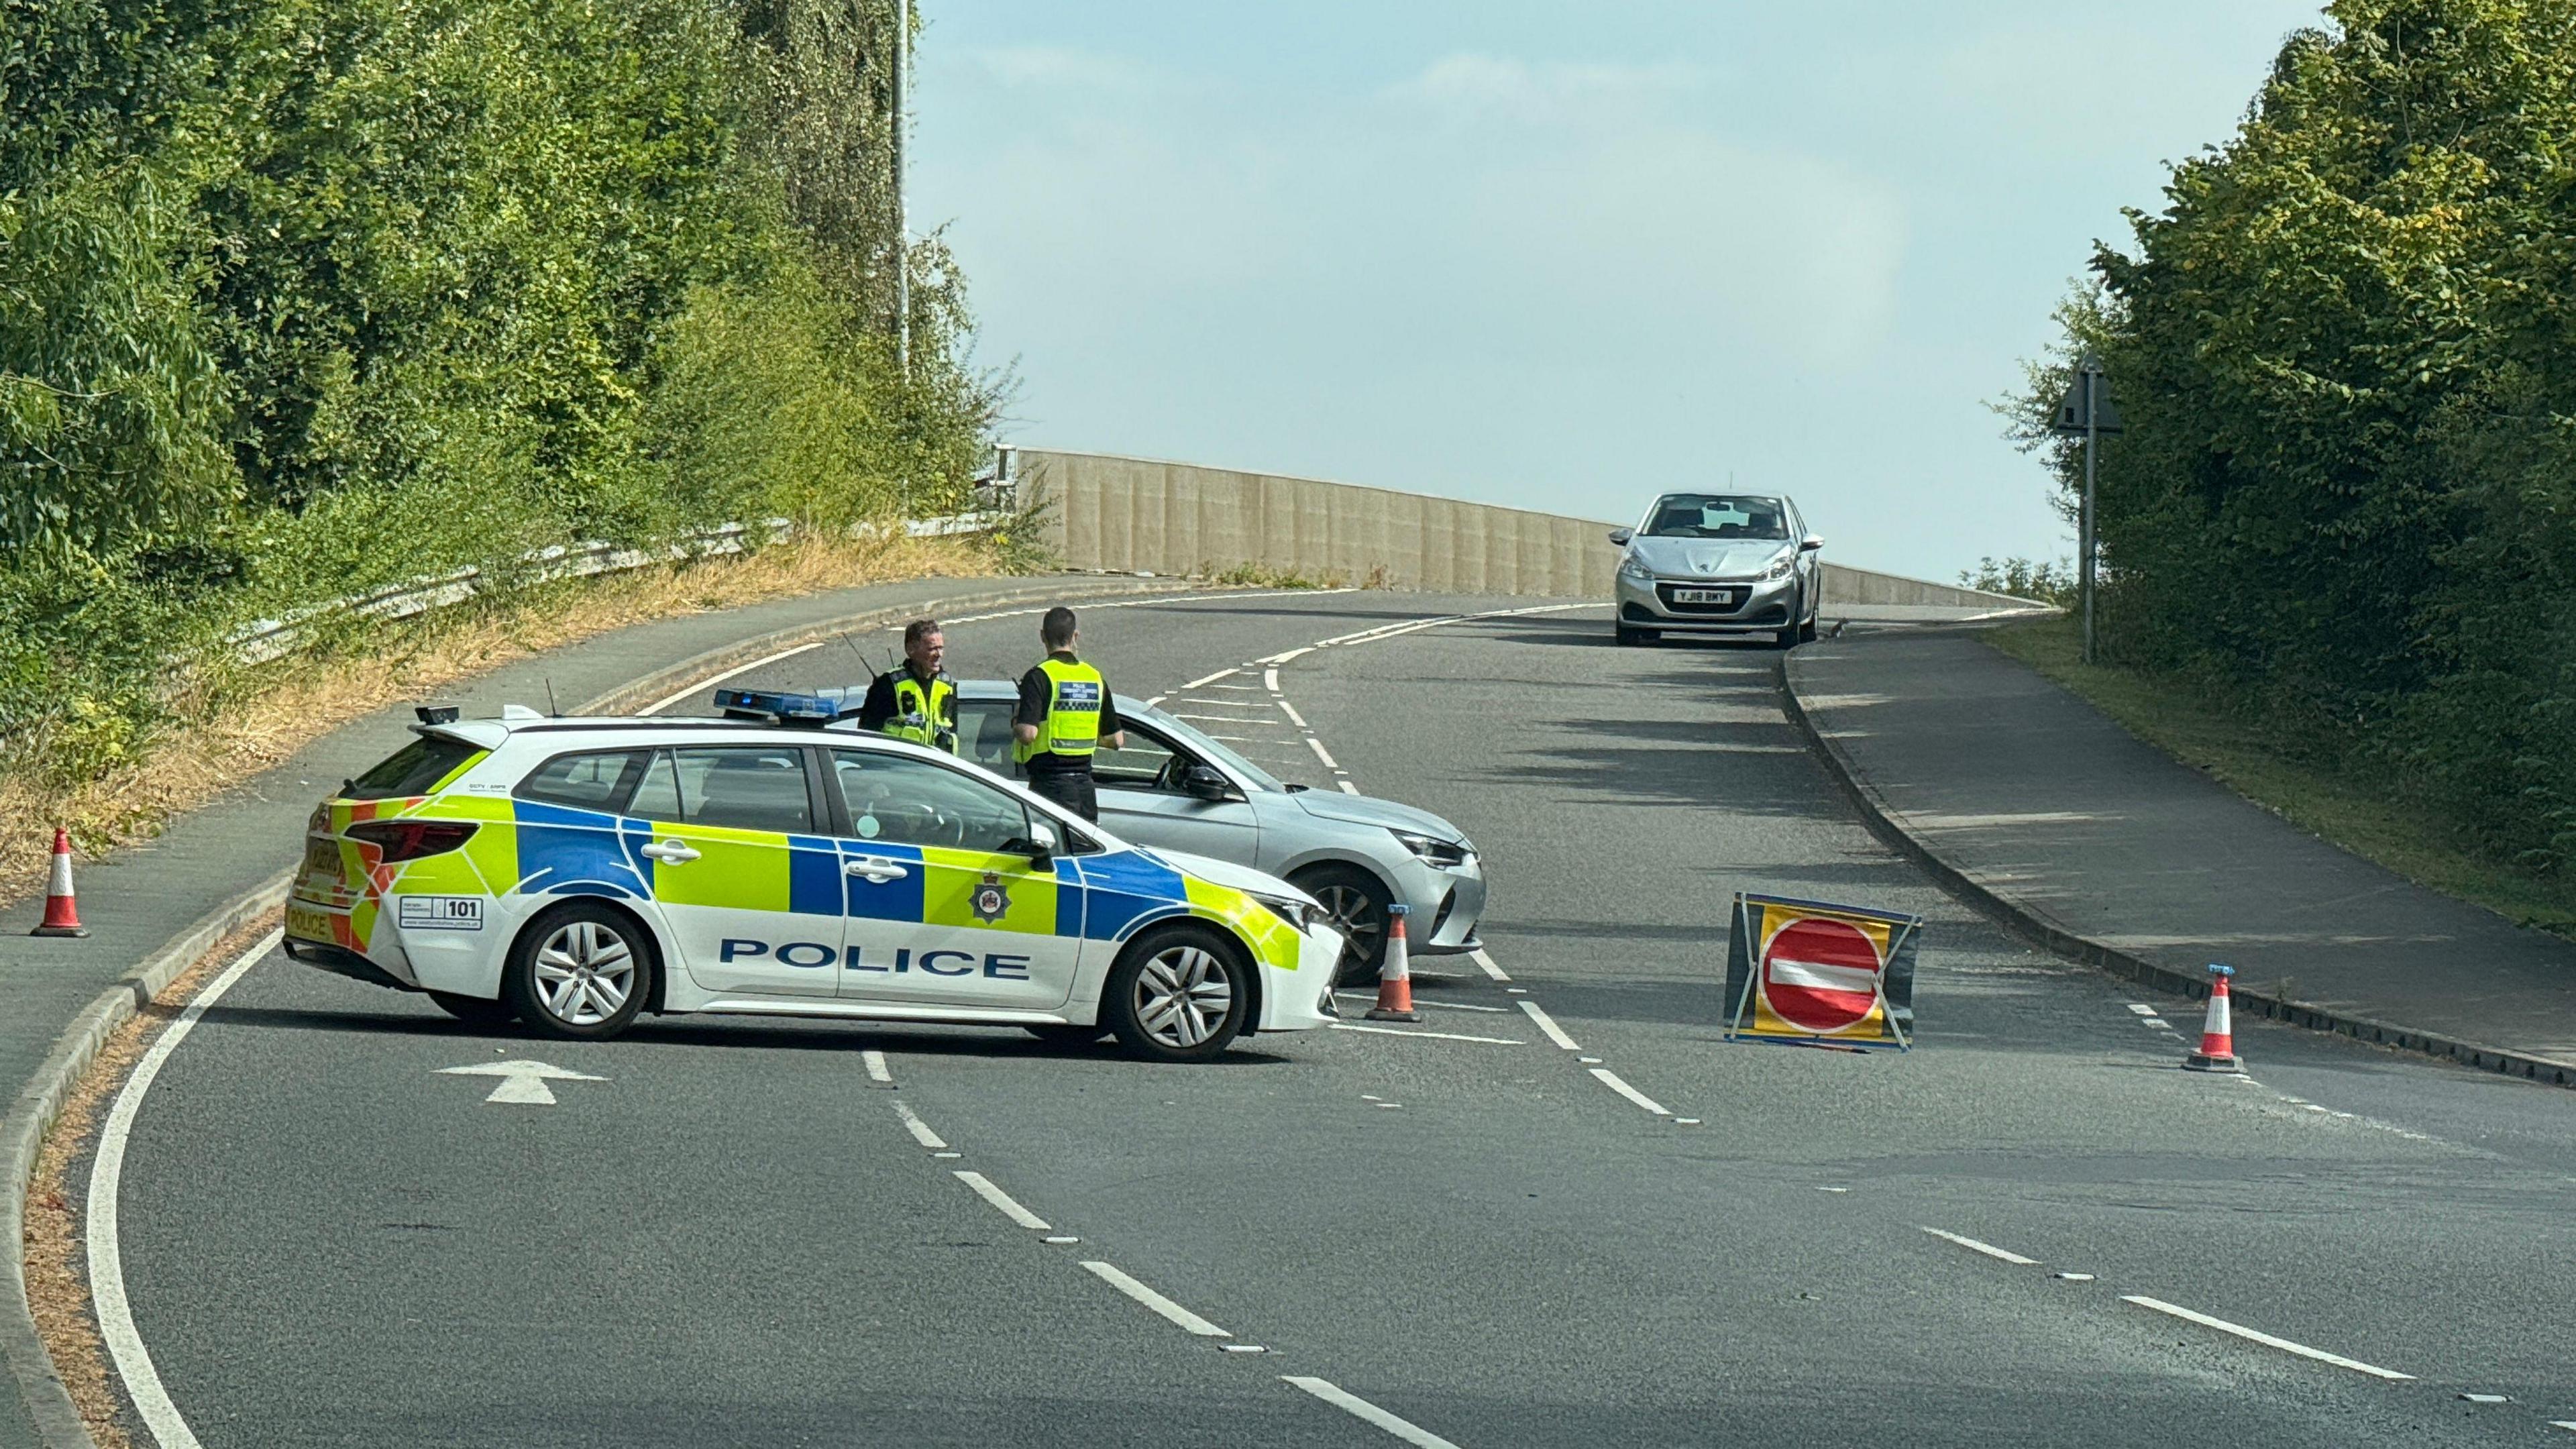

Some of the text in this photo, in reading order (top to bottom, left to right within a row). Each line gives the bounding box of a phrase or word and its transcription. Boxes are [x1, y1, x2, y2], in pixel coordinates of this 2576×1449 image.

[290, 909, 328, 935] POLICE
[449, 901, 476, 917] 101
[719, 938, 1031, 981] POLICE
